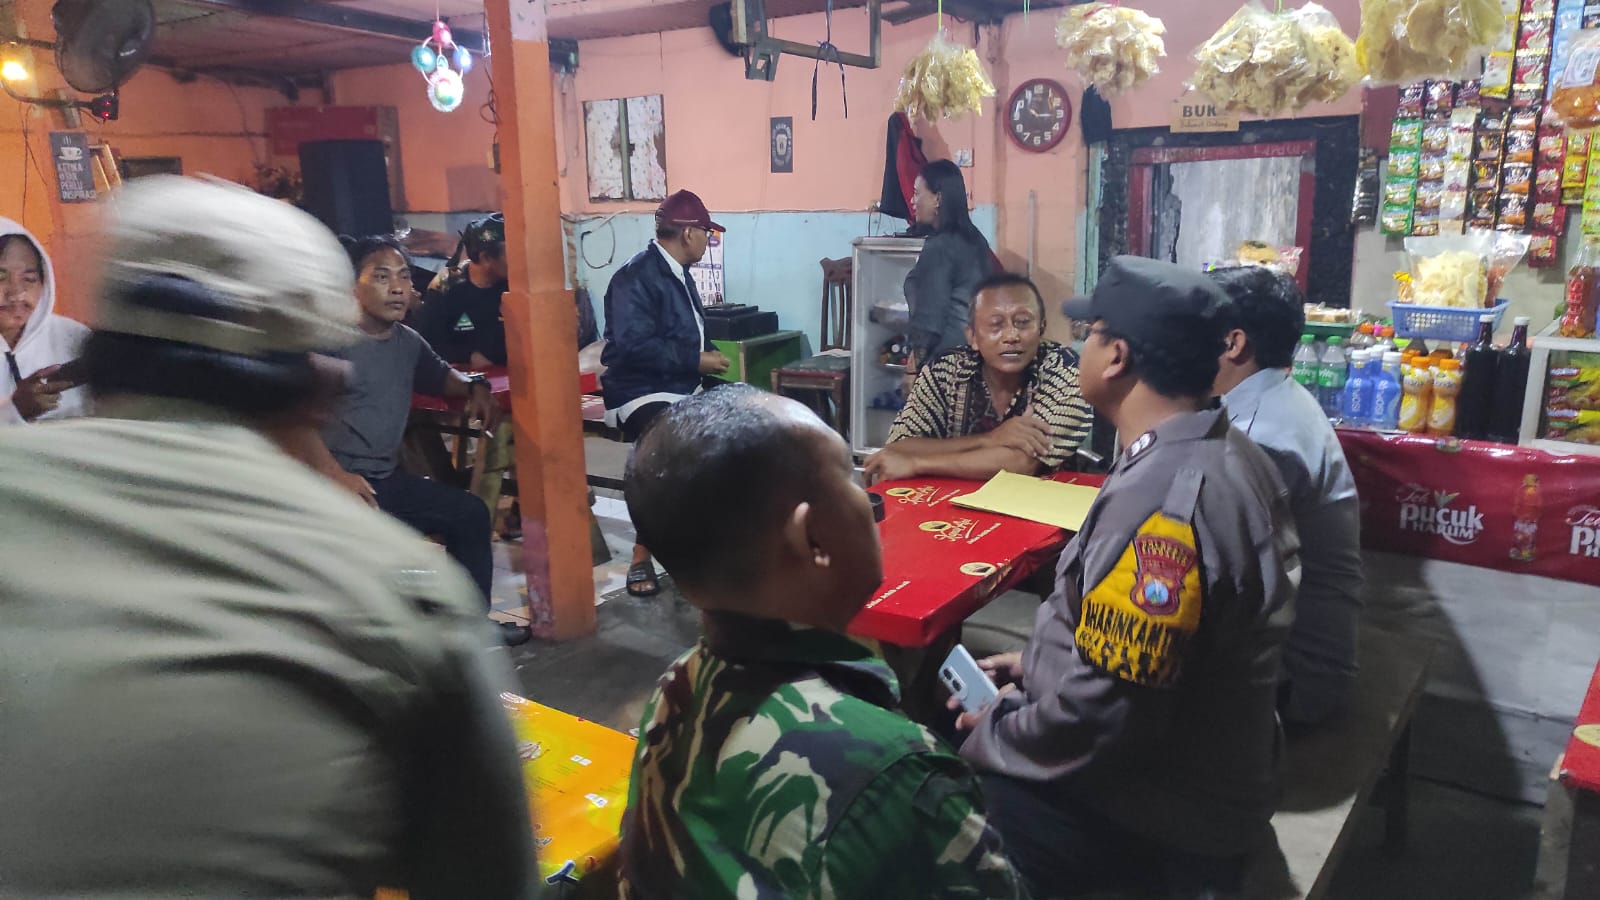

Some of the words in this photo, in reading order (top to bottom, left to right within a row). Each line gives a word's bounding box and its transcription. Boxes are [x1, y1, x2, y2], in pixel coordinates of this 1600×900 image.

[1056, 109, 1064, 119] 3
[1182, 104, 1217, 118] BUK
[1052, 122, 1060, 131] 4
[1023, 132, 1031, 141] 7
[1033, 136, 1041, 145] 6
[1044, 131, 1052, 141] 5
[1400, 504, 1484, 531] pucuk
[1411, 521, 1475, 540] HARUM
